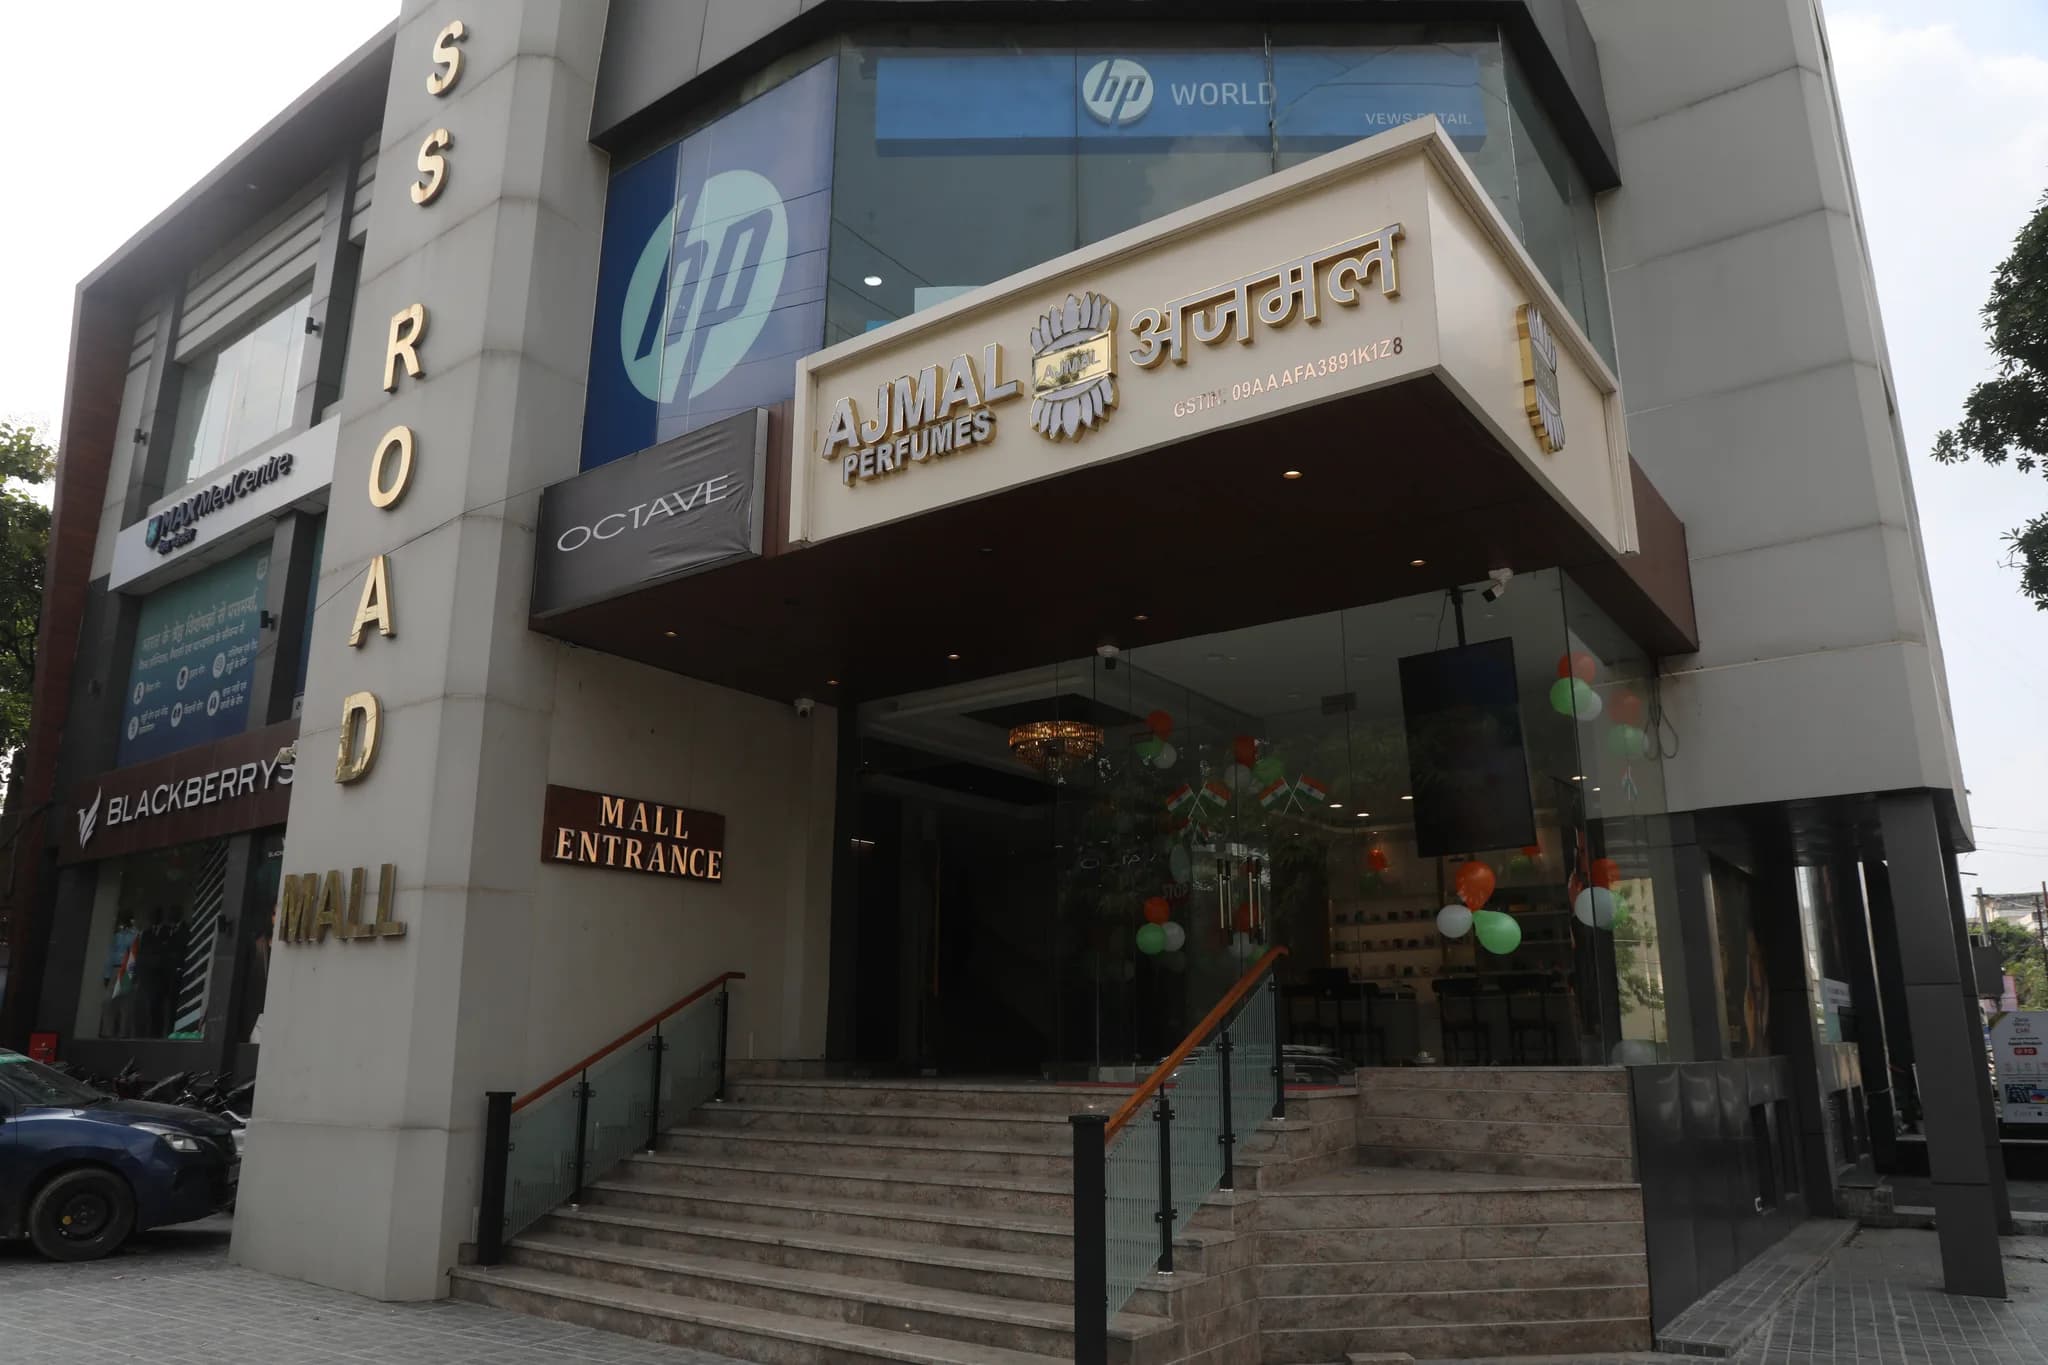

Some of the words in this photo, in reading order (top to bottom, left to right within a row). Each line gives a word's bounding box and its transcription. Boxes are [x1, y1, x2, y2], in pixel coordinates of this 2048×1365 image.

[1091, 58, 1147, 126] hp
[1170, 82, 1277, 106] WORLD
[1365, 112, 1413, 125] VEWS
[1417, 112, 1473, 126] RTAIL
[632, 190, 774, 402] hp
[1128, 221, 1406, 369] अजमल
[823, 342, 1024, 460] AJMAL
[1042, 351, 1102, 383] AJMAL
[842, 409, 997, 488] PERFUMES
[556, 474, 730, 552] OCTAVE
[554, 827, 722, 880] ENTRANCE
[600, 795, 689, 839] MALL
[278, 863, 407, 943] MALL
